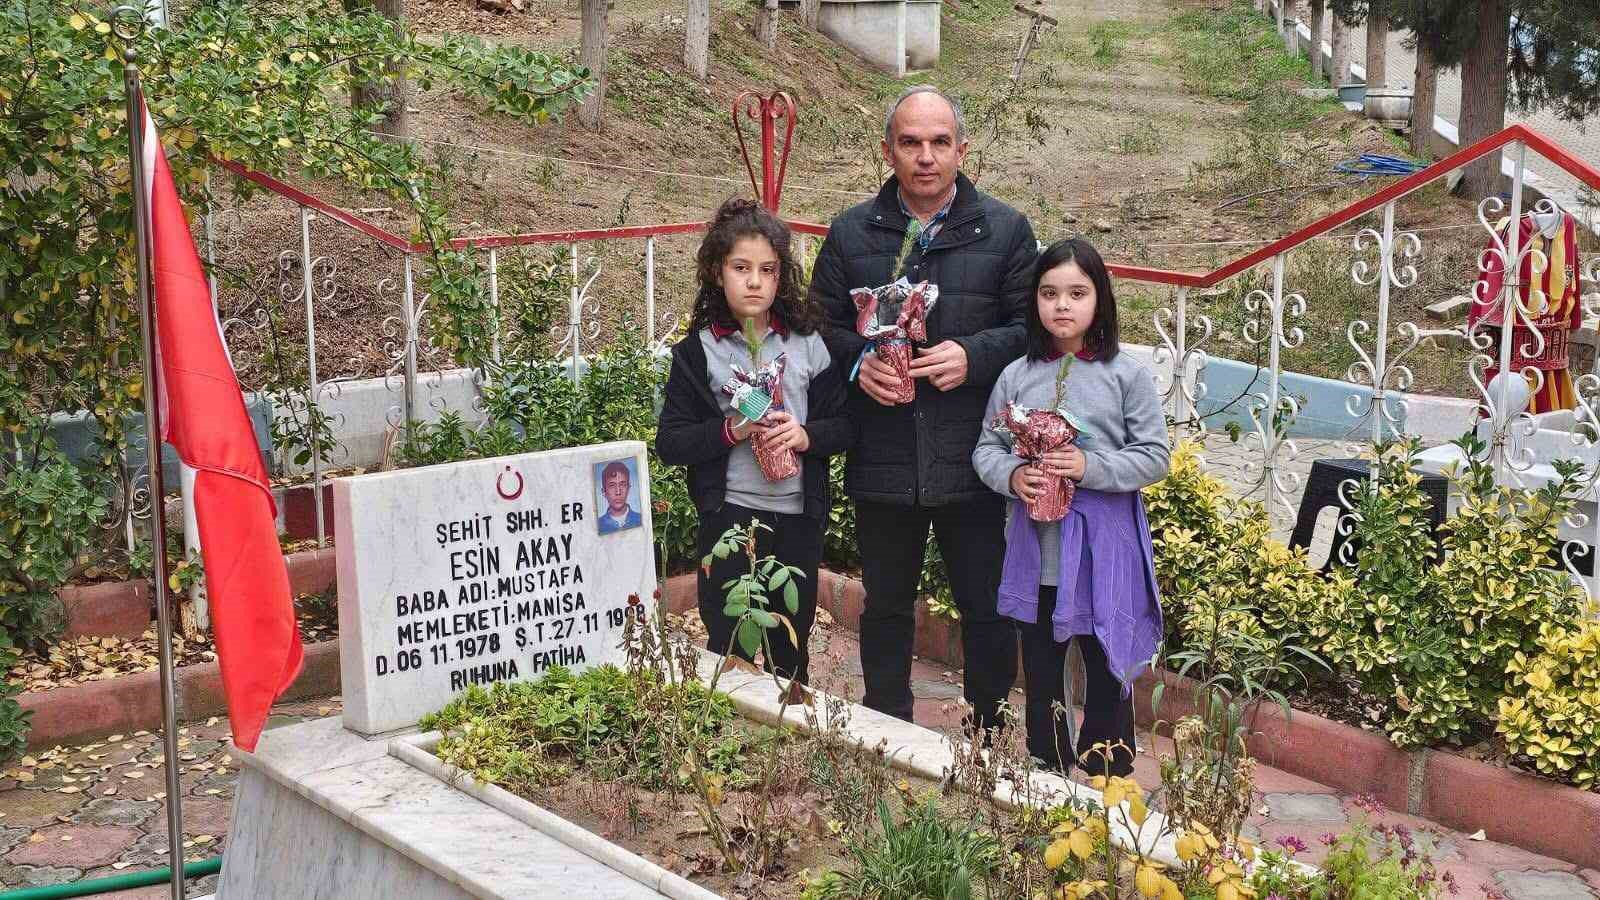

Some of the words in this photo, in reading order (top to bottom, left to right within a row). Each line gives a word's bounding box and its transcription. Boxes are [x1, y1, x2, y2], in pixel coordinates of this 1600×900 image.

[436, 513, 492, 548] ŞEHİT
[506, 508, 548, 534] SHH.
[561, 502, 583, 524] ER
[450, 542, 500, 581] ESİN
[516, 533, 572, 571] AKAY
[397, 589, 449, 617] BABA
[450, 659, 518, 691] RUHUNA
[533, 644, 586, 673] FATİHA
